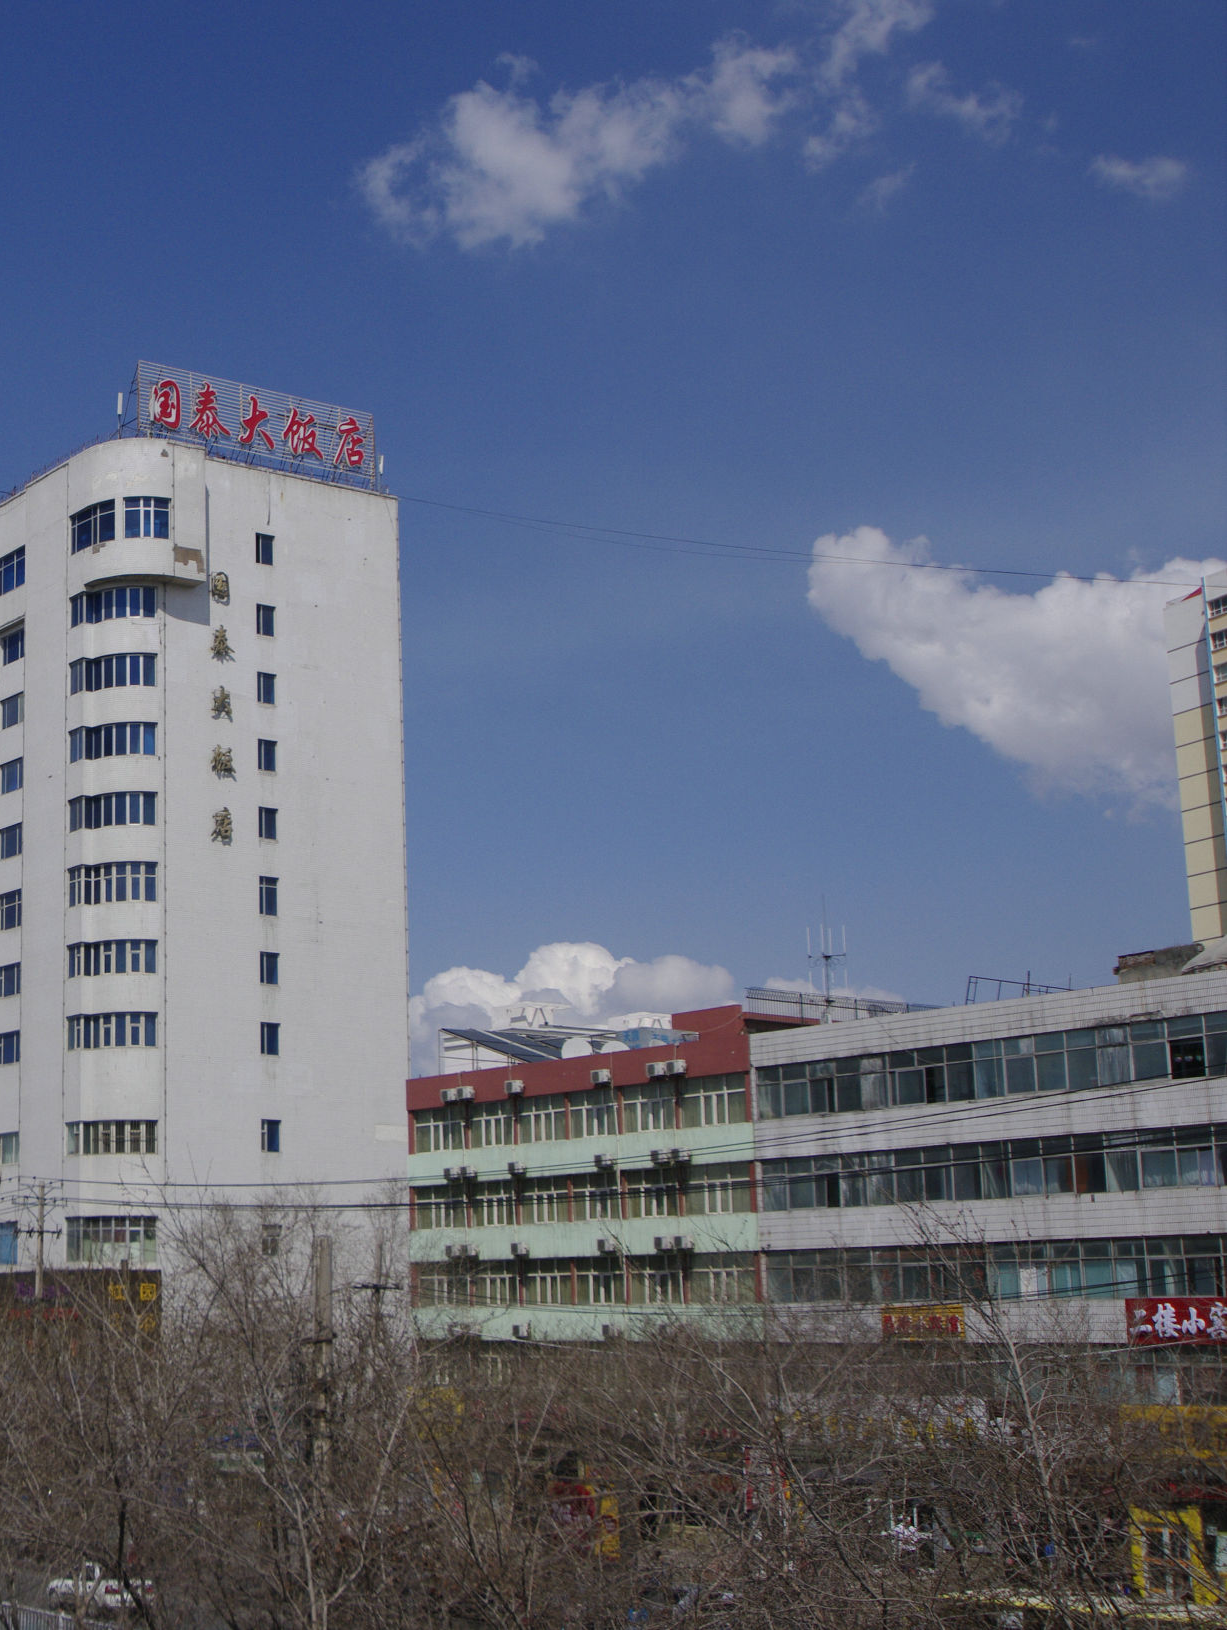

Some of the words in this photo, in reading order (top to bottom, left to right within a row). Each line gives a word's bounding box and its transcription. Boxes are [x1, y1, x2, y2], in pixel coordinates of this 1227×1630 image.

[150, 379, 366, 467] 国泰大饭店
[211, 571, 236, 839] 国泰大饭店
